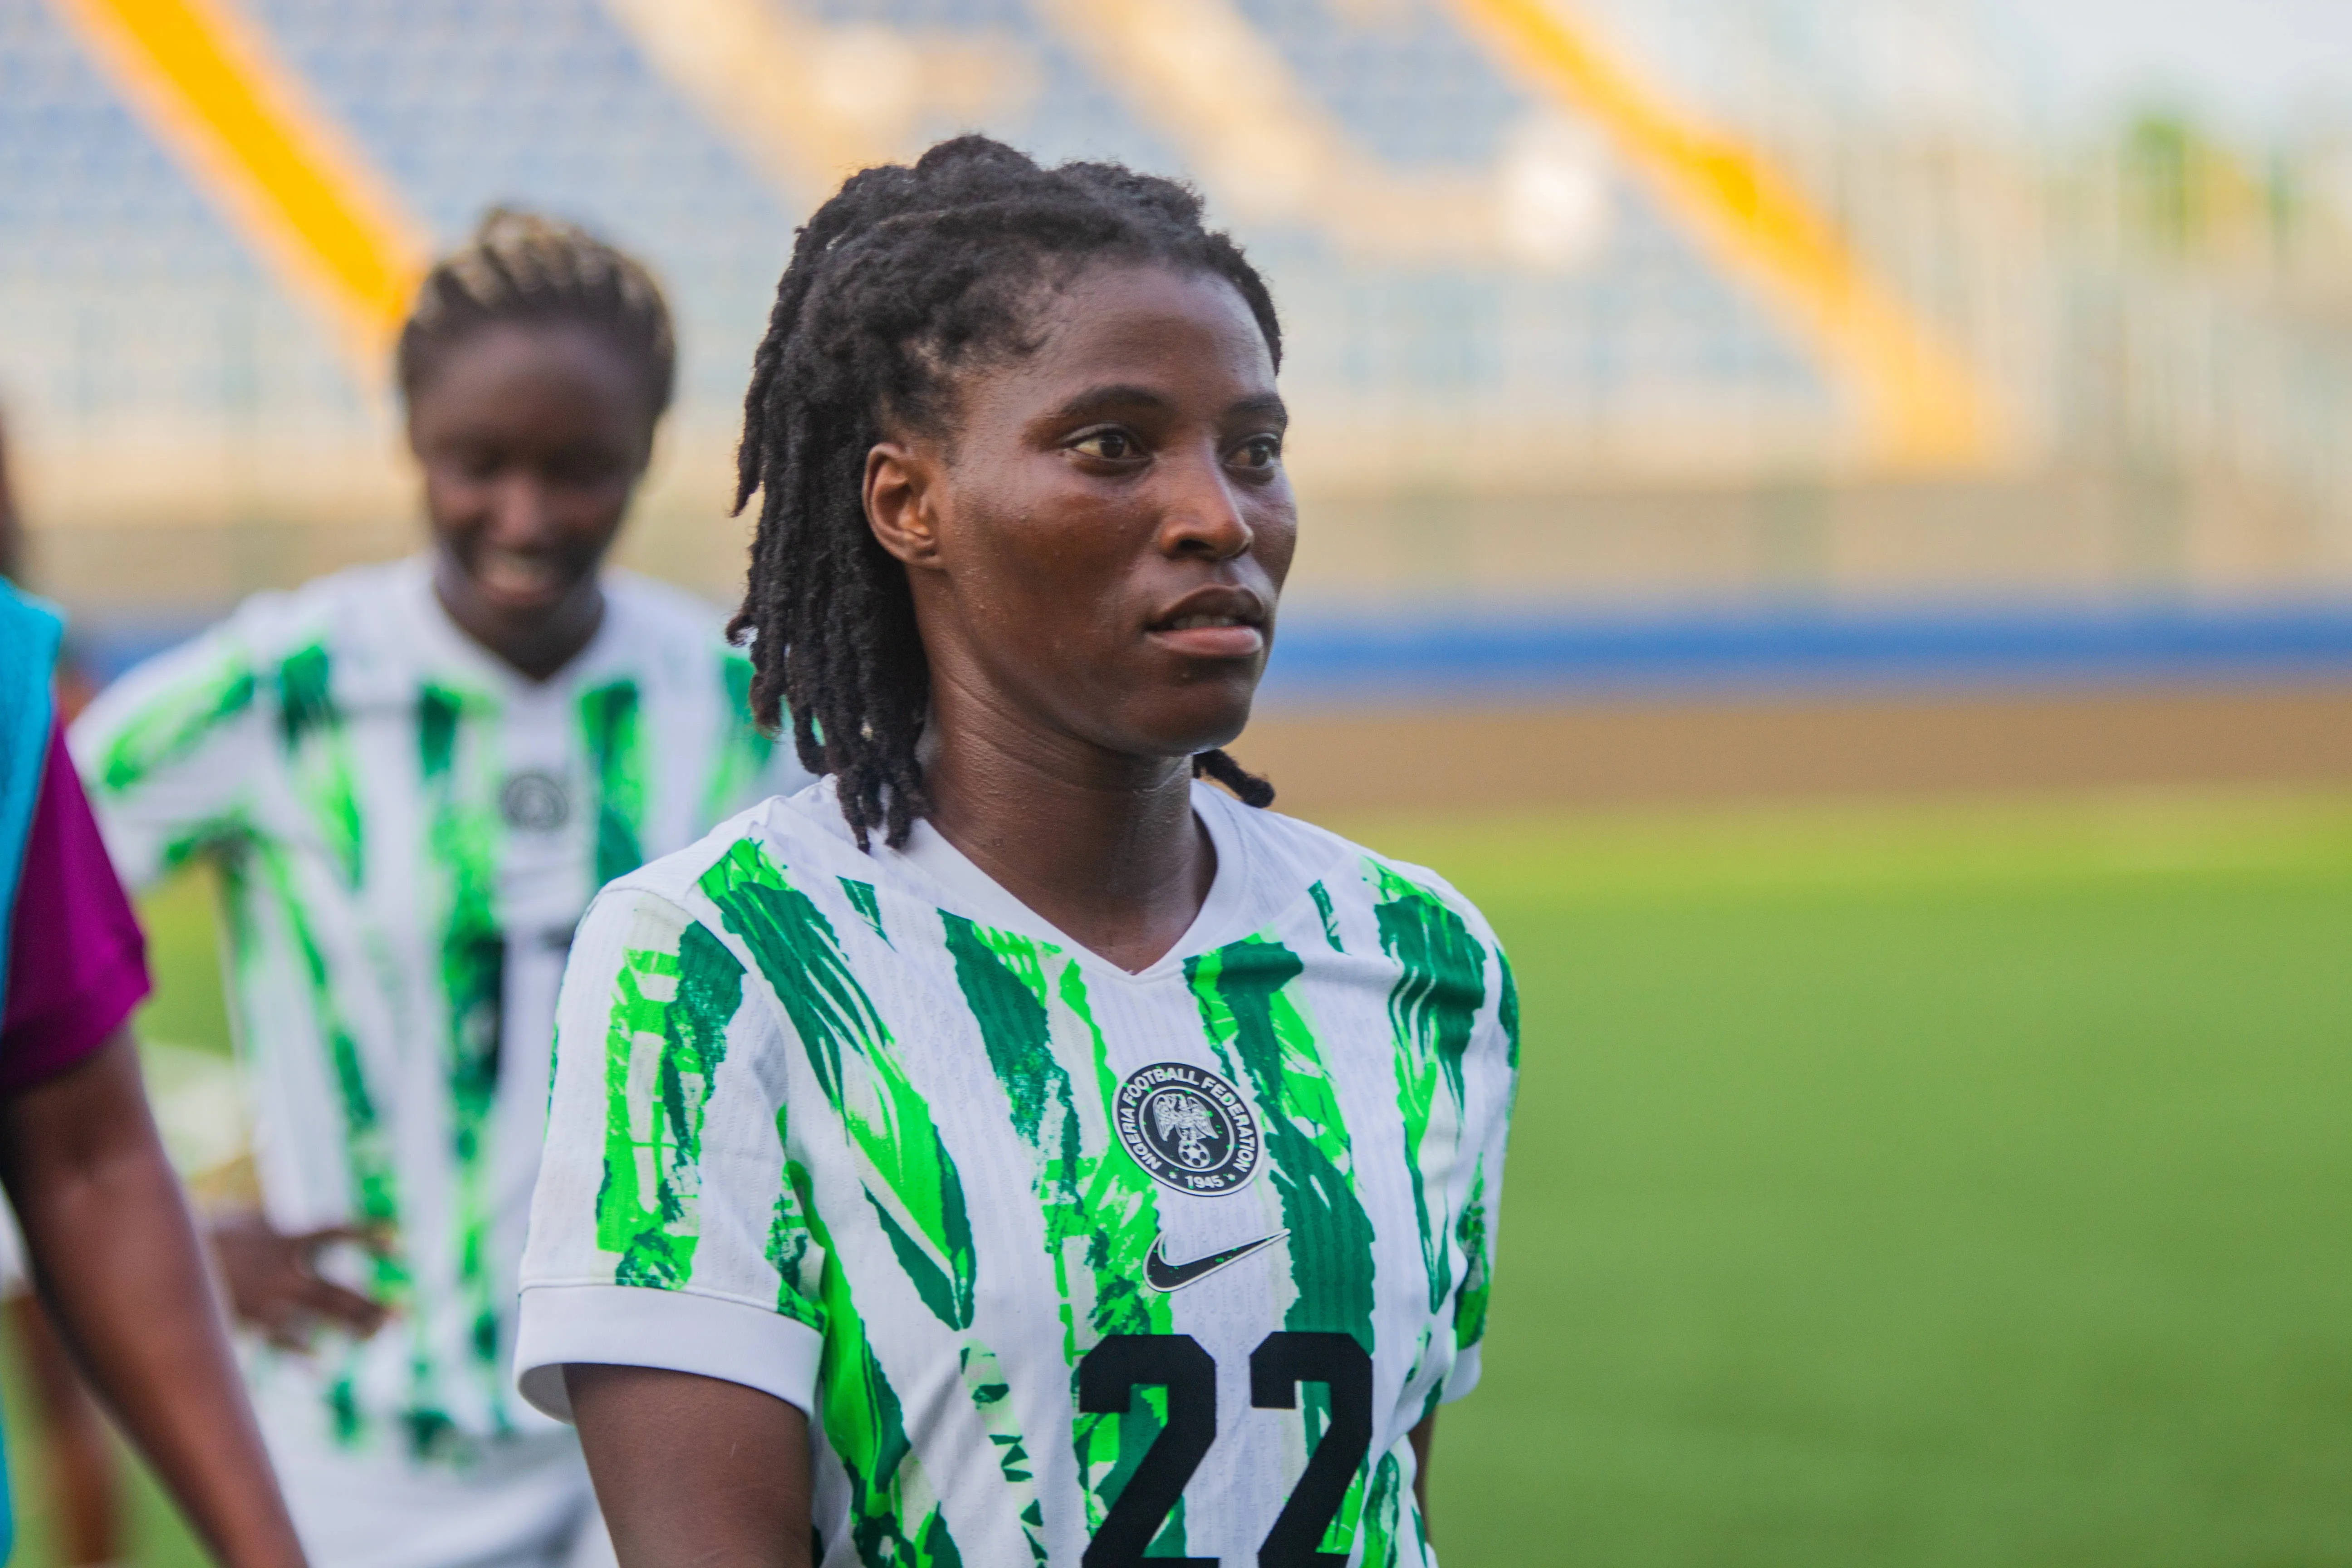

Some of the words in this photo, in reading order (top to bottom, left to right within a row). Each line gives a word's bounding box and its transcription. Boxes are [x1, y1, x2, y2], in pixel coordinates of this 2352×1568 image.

[1122, 1068, 1199, 1107] FOOTBALL
[1120, 1107, 1162, 1170] NIGERIA
[1201, 1077, 1255, 1172] FEDERATION
[1185, 1175, 1224, 1189] 1945
[1079, 1332, 1373, 1568] 22
